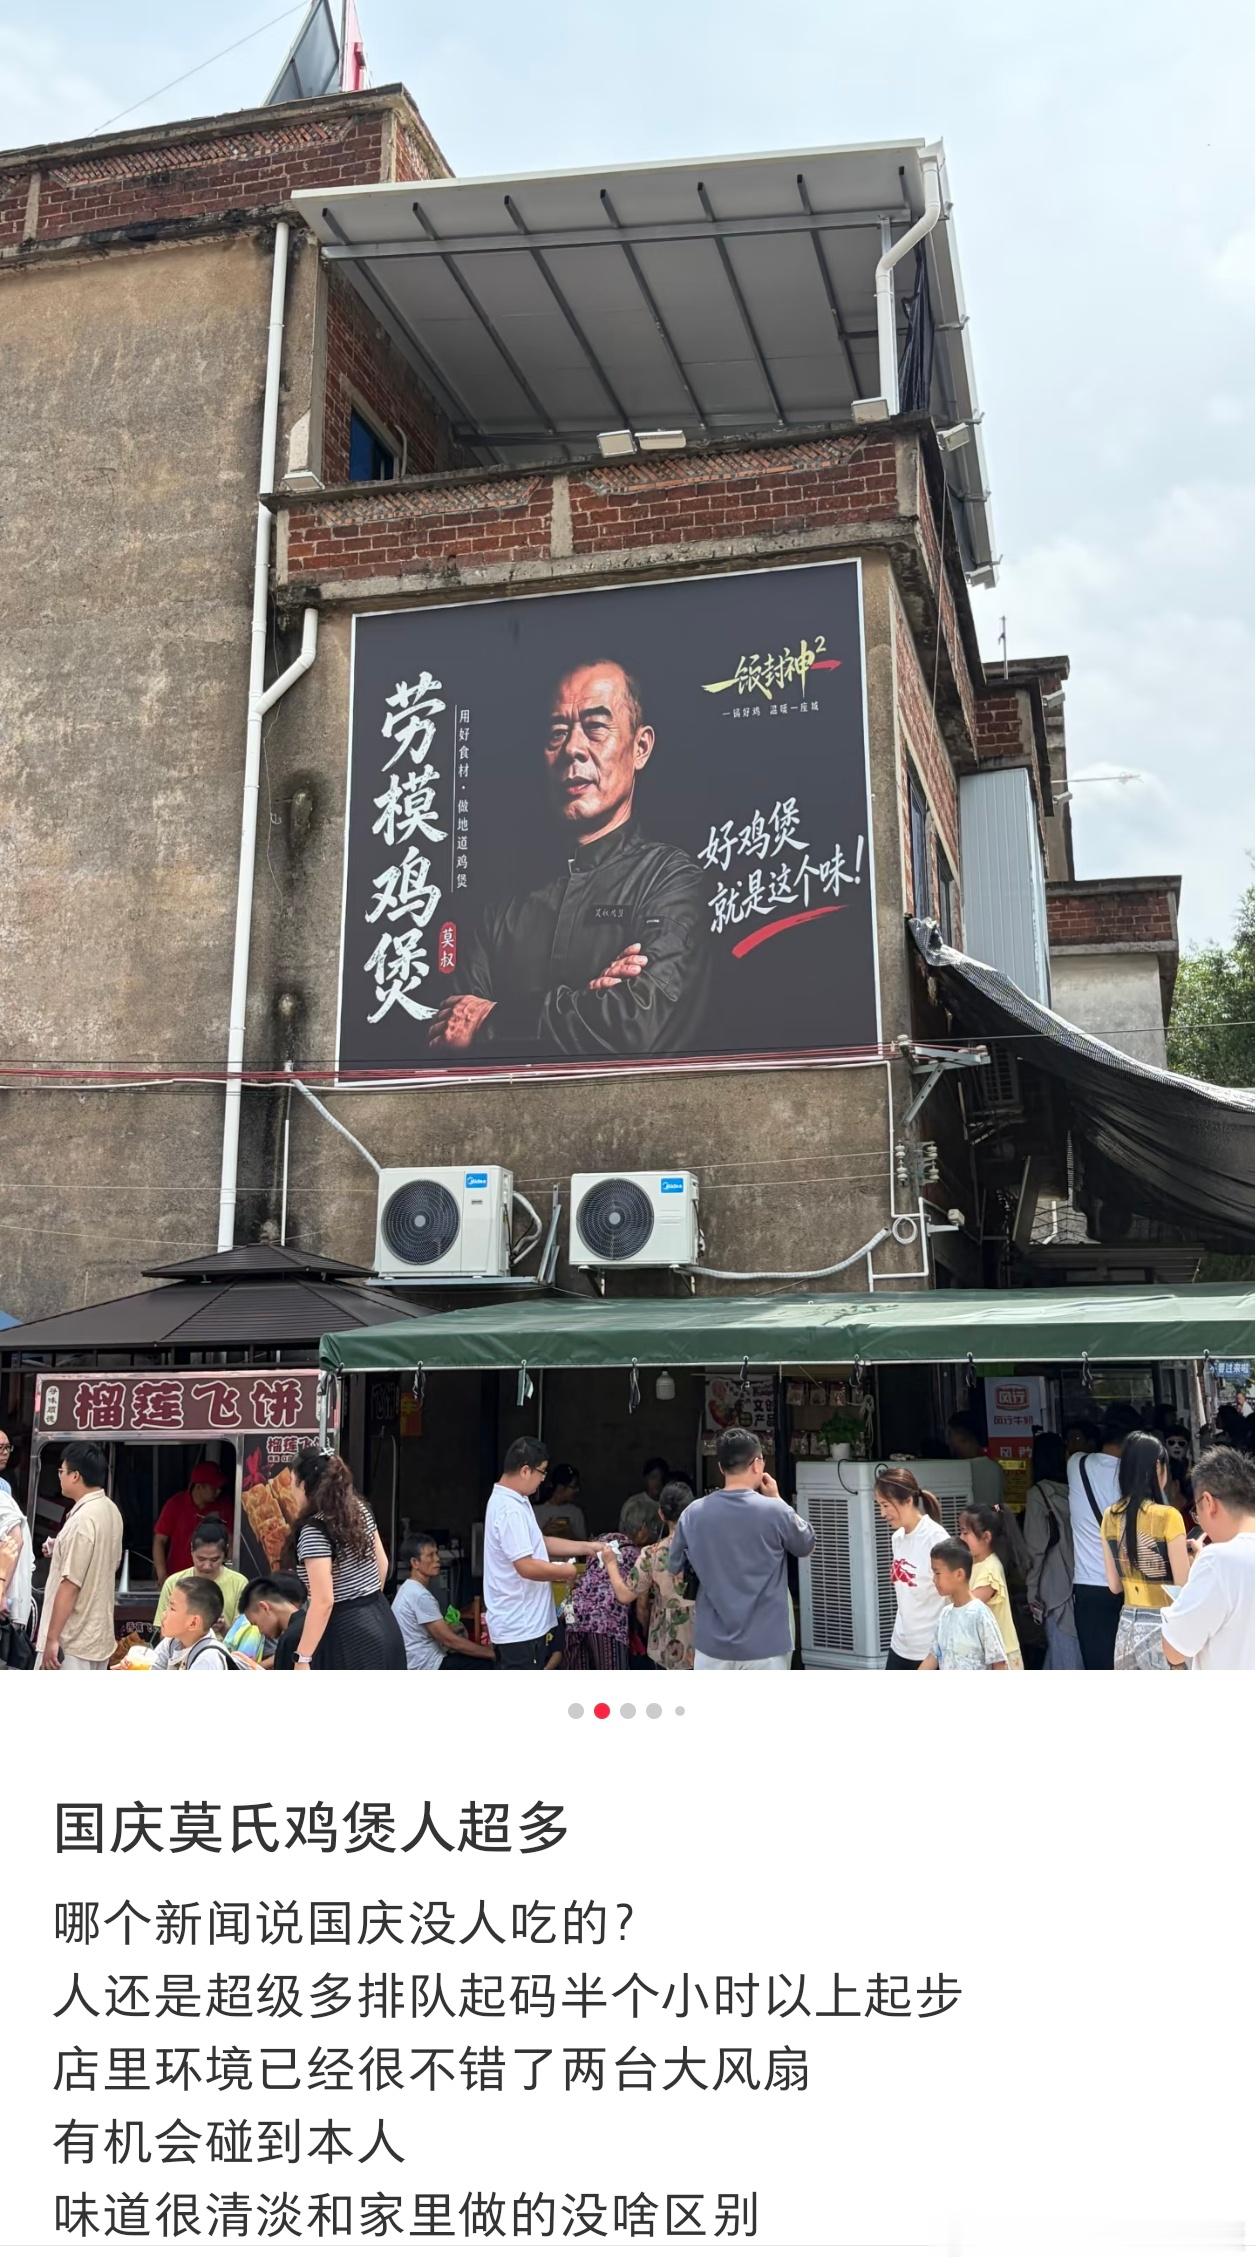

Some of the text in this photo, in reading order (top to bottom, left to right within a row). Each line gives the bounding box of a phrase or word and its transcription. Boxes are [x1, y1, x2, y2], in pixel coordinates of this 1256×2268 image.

[363, 671, 448, 1024] 劳模鸡煲
[697, 797, 810, 871] 好鸡煲
[441, 927, 455, 968] 莫叔
[74, 1378, 303, 1431] 榴莲飞饼
